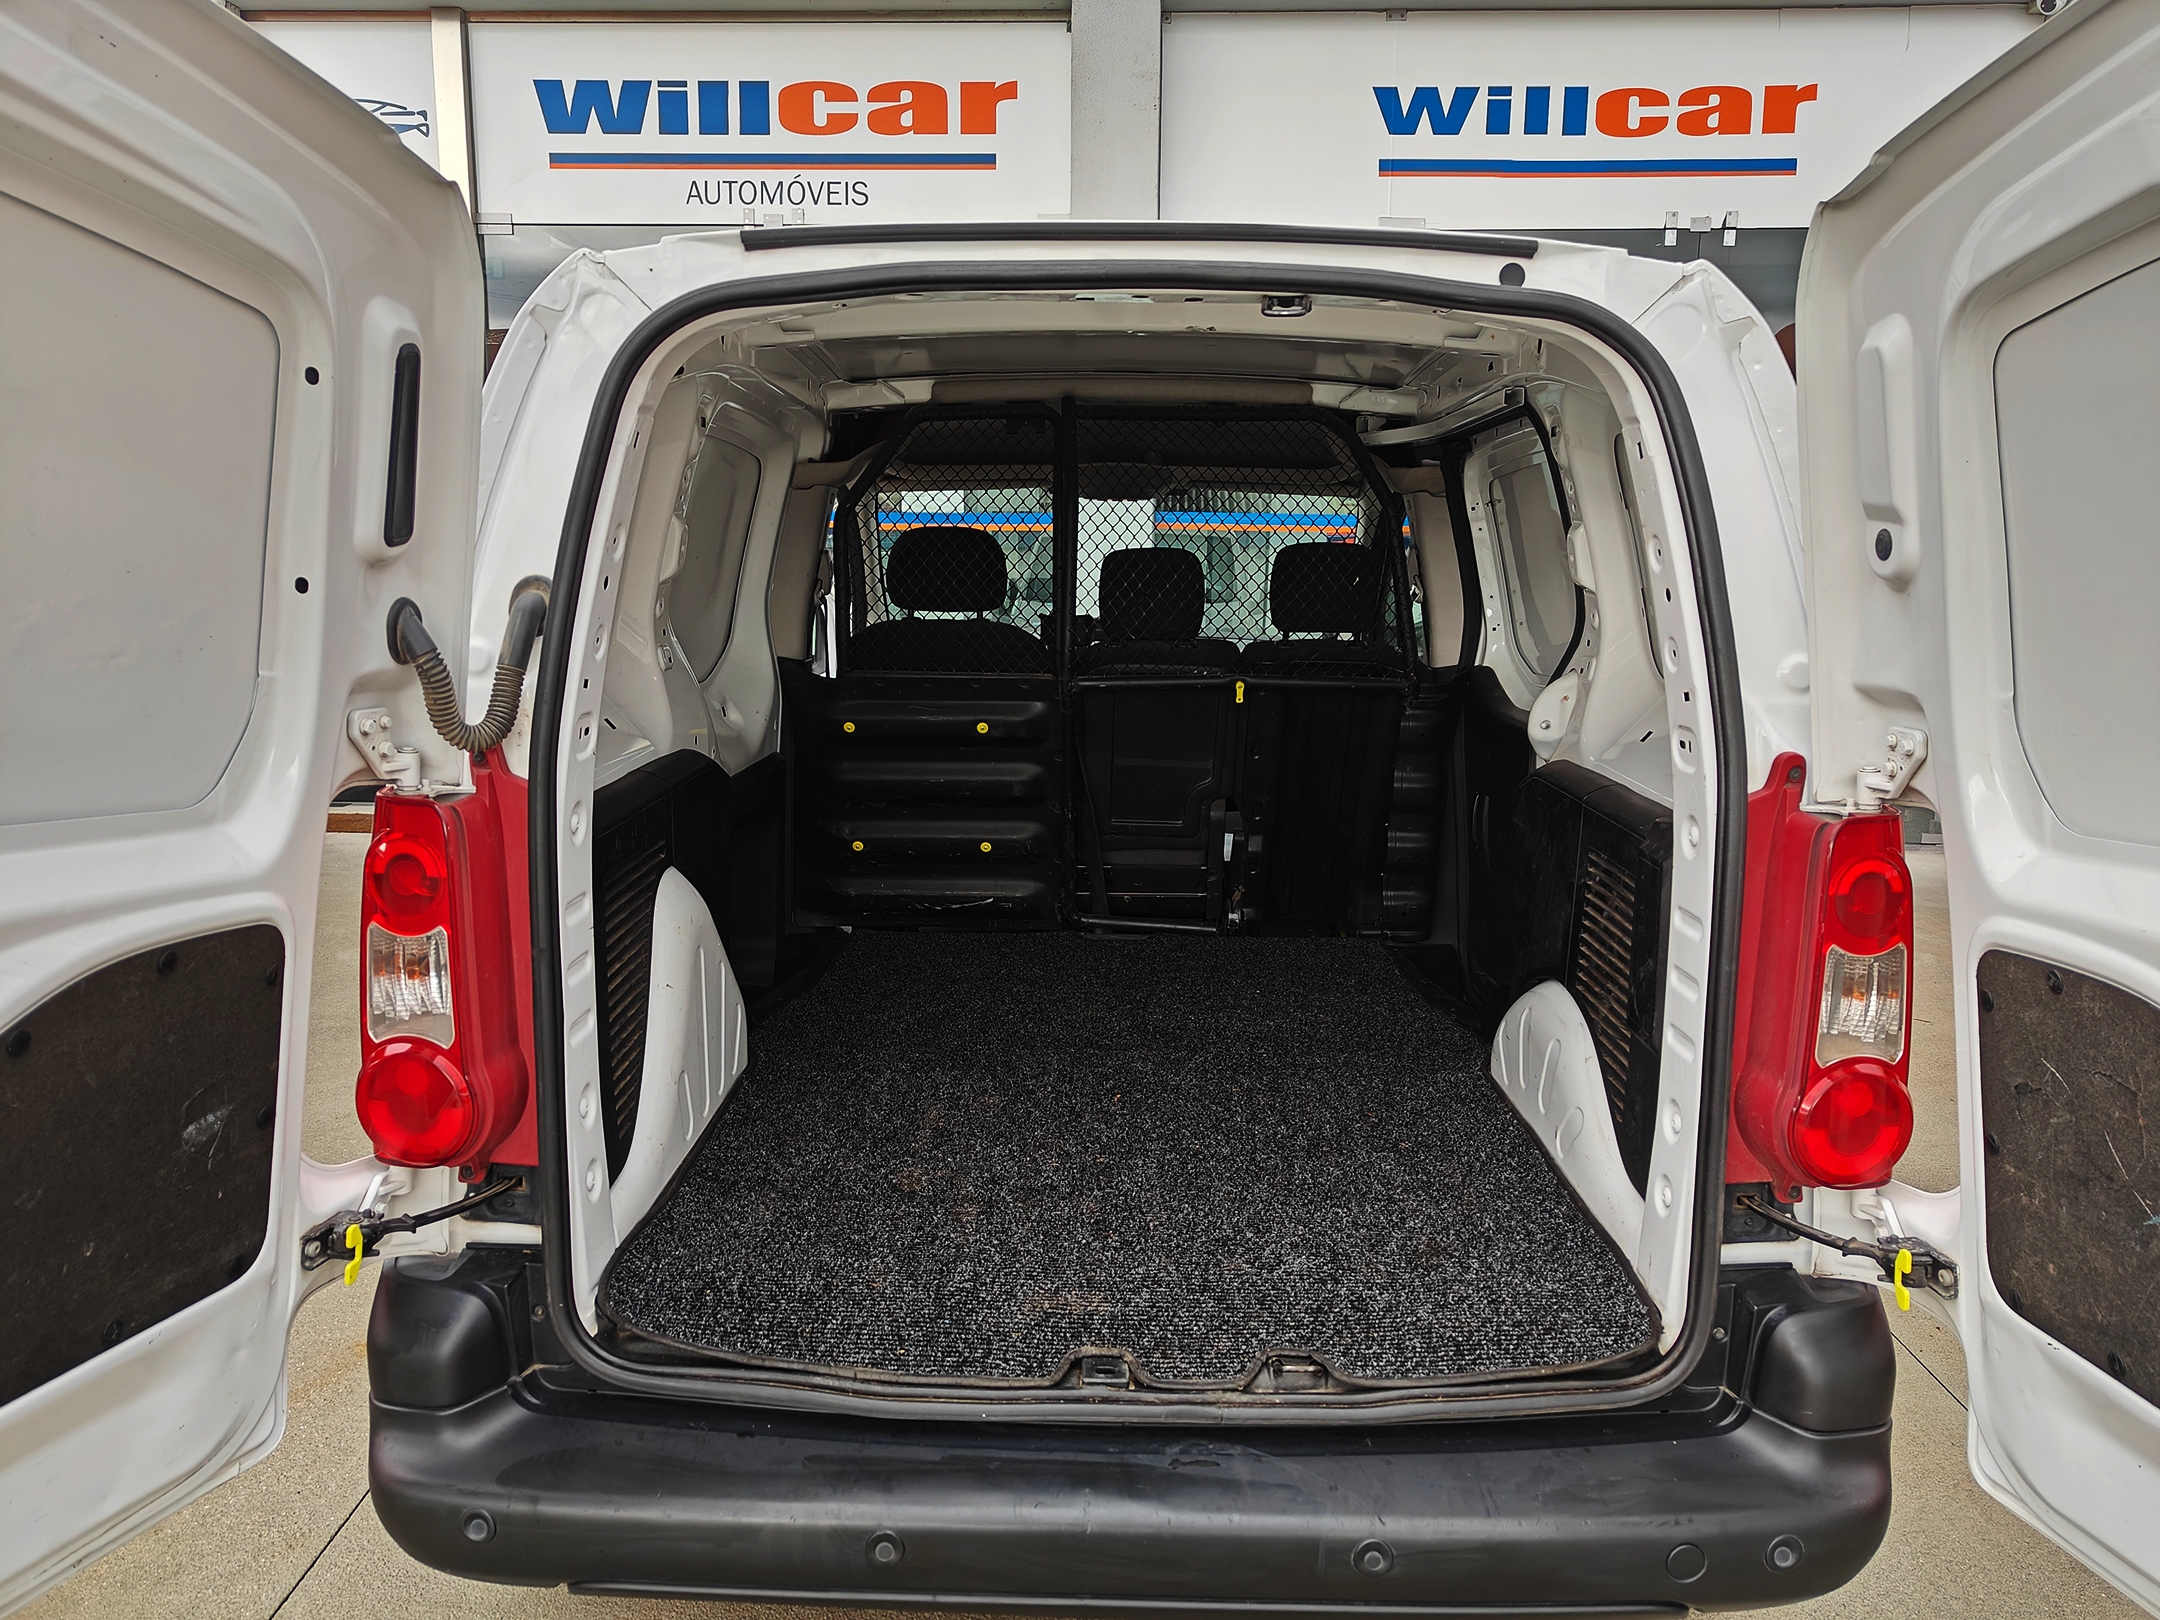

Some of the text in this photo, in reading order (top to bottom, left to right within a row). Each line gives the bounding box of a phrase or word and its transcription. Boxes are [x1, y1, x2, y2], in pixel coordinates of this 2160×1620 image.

[533, 79, 1018, 136] willcar
[1372, 83, 1819, 138] willcar
[686, 173, 869, 207] AUTOMÓVEIS
